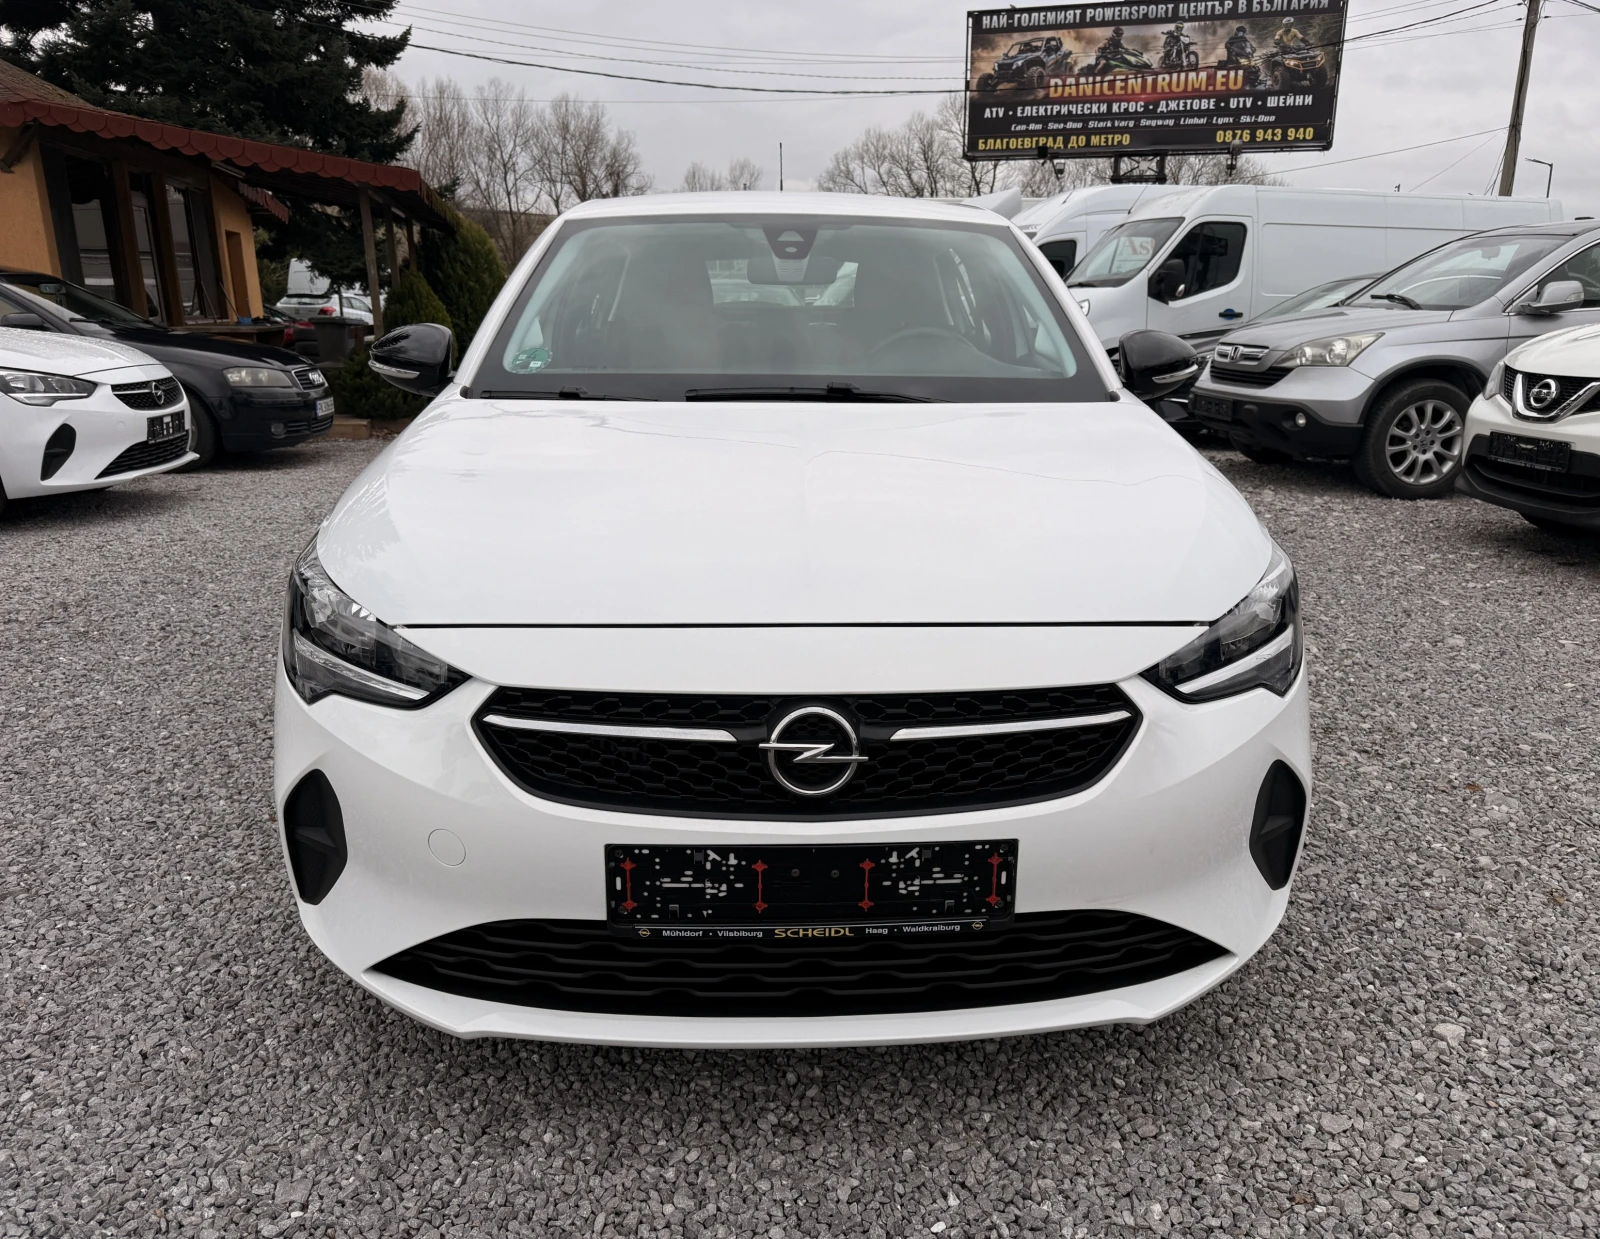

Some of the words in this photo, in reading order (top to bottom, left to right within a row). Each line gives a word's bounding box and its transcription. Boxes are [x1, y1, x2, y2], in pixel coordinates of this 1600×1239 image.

[982, 10, 1082, 29] НАЙ-ГОЛЕМИЯТ
[1086, 4, 1174, 22] POWERSPORT
[1179, 1, 1234, 18] ЦЕНТЪР
[1238, 0, 1247, 13] В
[1252, 0, 1328, 12] БЪЛГАРИЯ
[1049, 70, 1244, 97] DANICENTRUM.EU
[984, 107, 1005, 118] ATV
[1017, 104, 1107, 117] ЕЛЕКТРИЧЕСКИ
[1112, 102, 1145, 113] КРОС
[1157, 98, 1216, 113] ДЖЕТОВЕ
[1230, 97, 1253, 108] UTV
[1267, 94, 1313, 107] ШЕЙНИ
[1011, 123, 1042, 131] Can-Am
[1047, 122, 1083, 130] Sea-Doo
[1114, 119, 1134, 128] Varg
[1180, 117, 1207, 125] Linhai
[1212, 117, 1234, 125] Lynx
[1240, 115, 1276, 123] Ski-Doo
[978, 136, 1064, 150] БЛАГОЕВГРАД
[1068, 135, 1086, 148] ДО
[1090, 134, 1130, 146] МЕТРО
[1216, 130, 1251, 143] 0876
[1256, 129, 1282, 141] 943
[1287, 127, 1314, 140] 940
[717, 930, 763, 938] Vilsbiburg
[774, 928, 854, 938] SCHEIDL
[865, 927, 888, 935] Haag
[903, 924, 961, 933] Waldkraiburg
